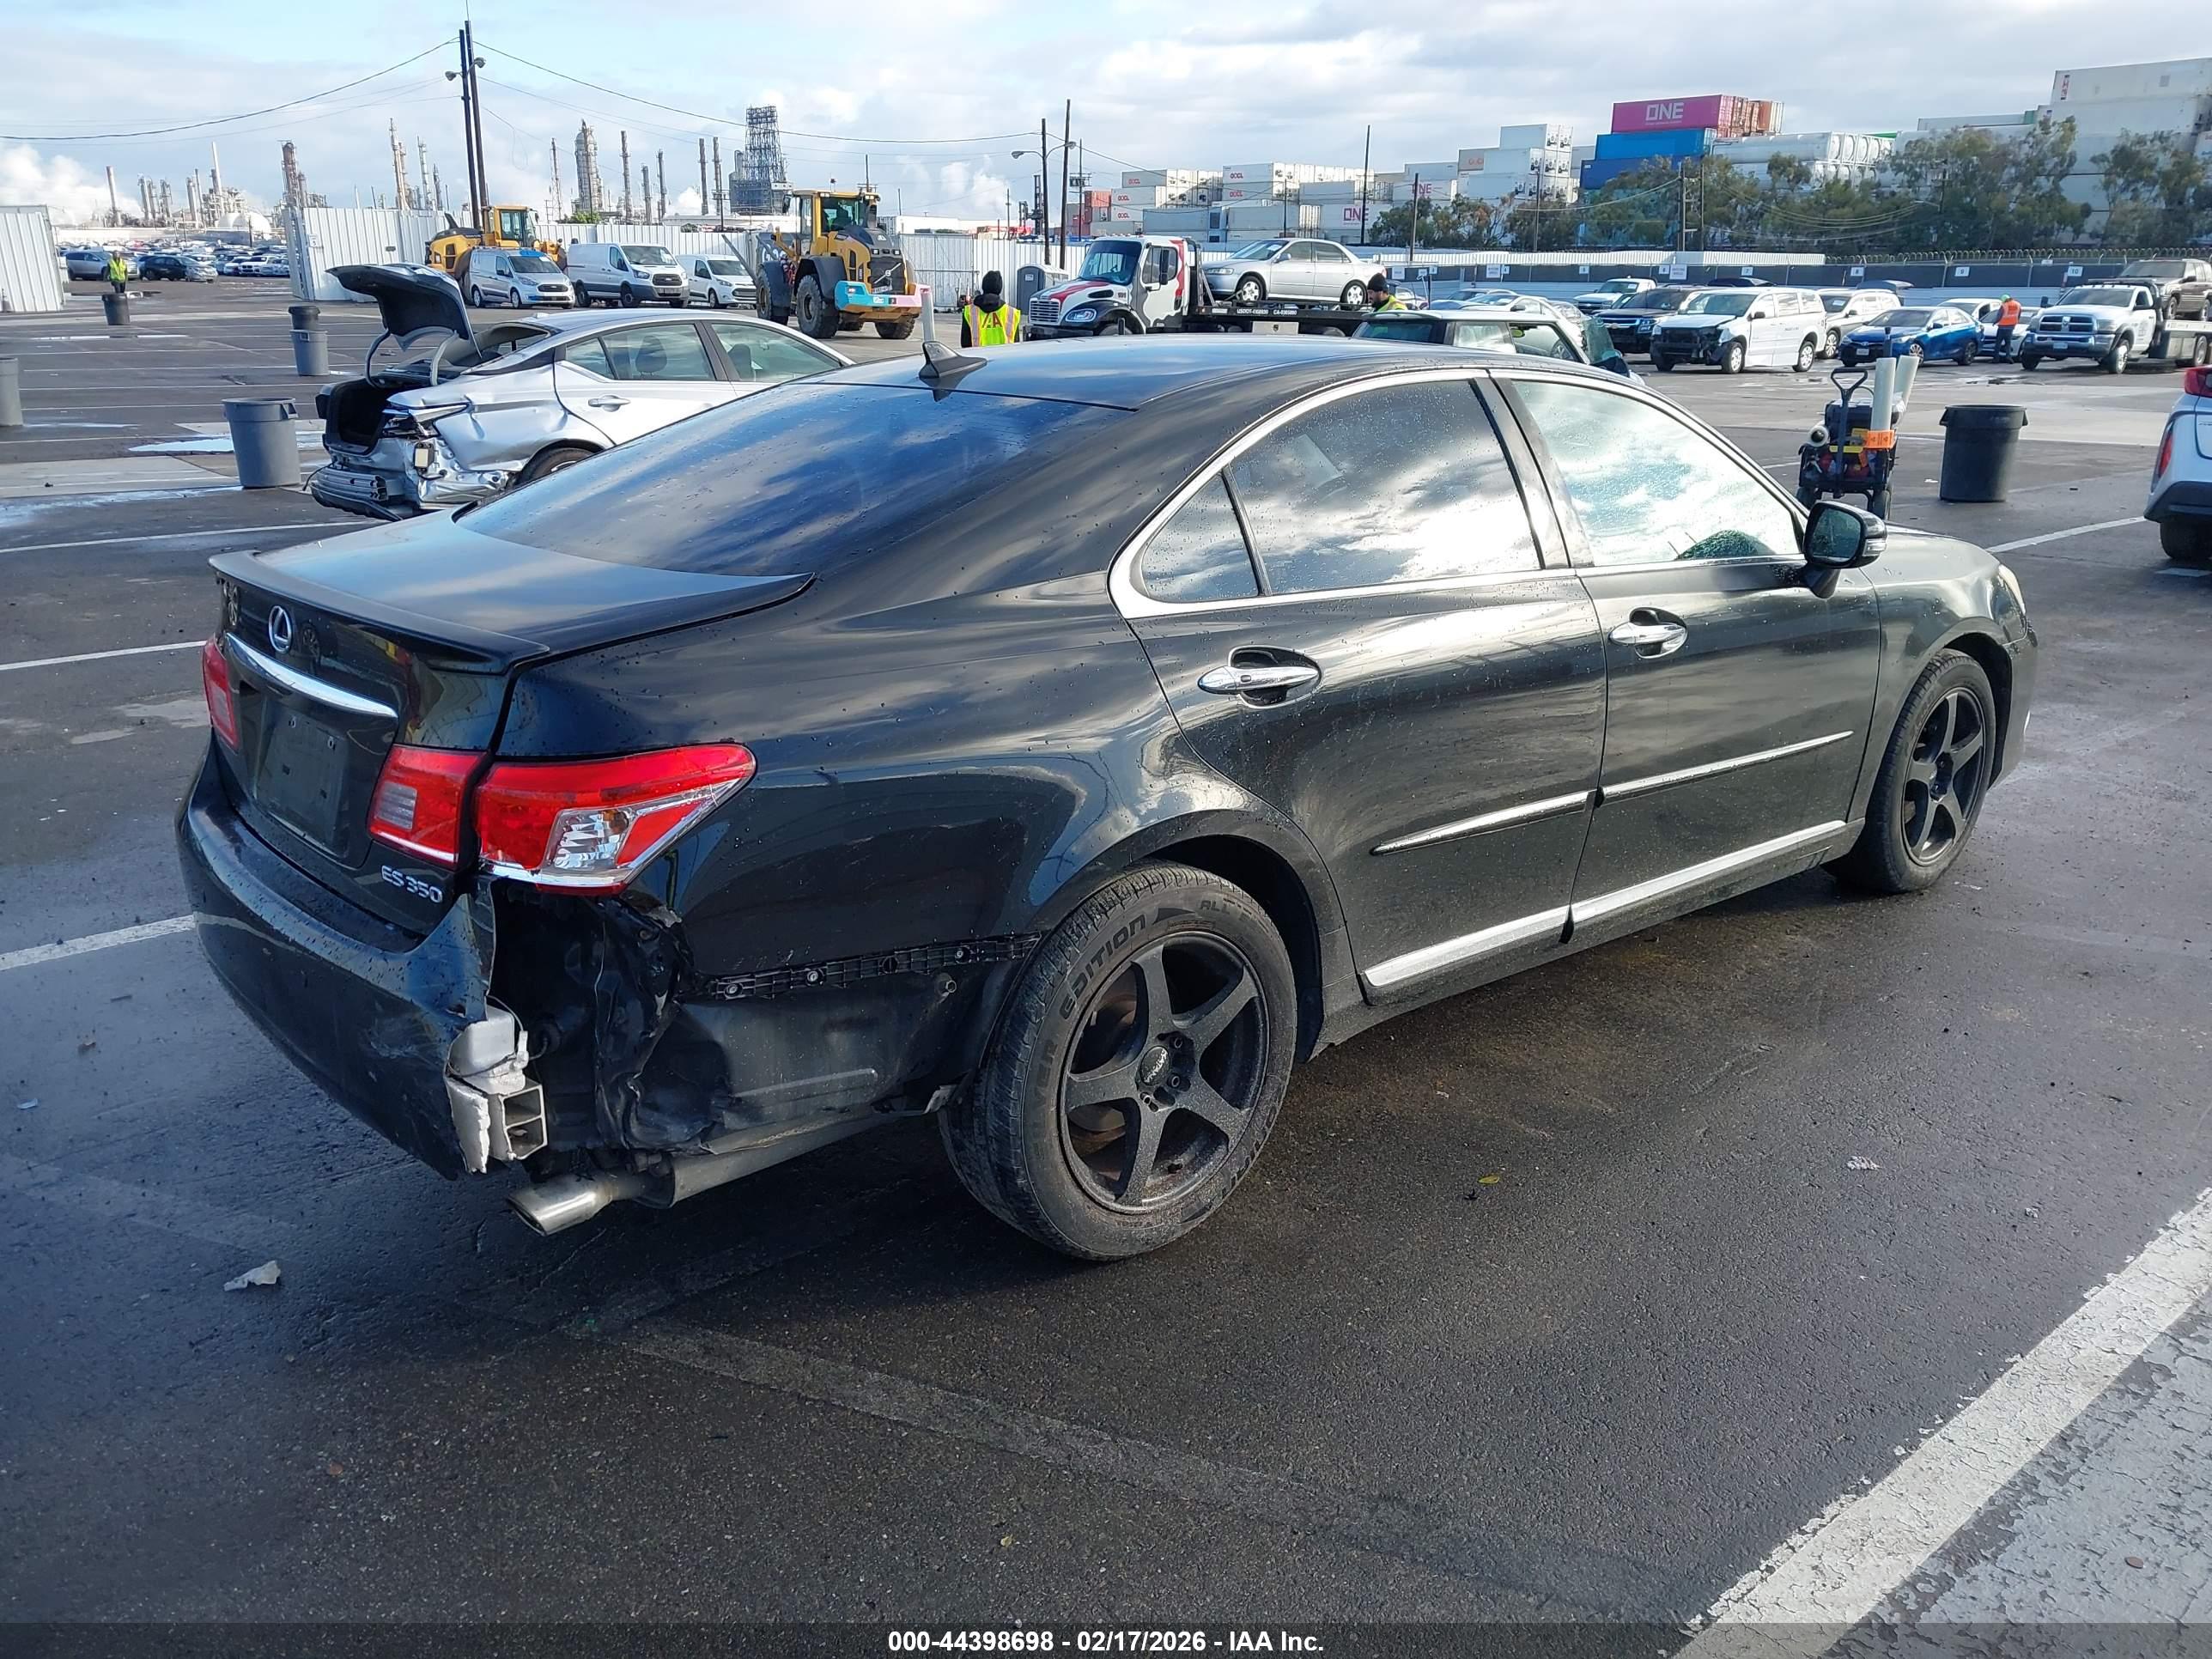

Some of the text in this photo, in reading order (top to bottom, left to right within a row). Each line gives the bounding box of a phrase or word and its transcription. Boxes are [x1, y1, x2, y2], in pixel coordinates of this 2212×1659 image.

[1645, 102, 1684, 121] ONE
[381, 865, 443, 903] ES 350
[1059, 914, 1147, 1020] EDITION
